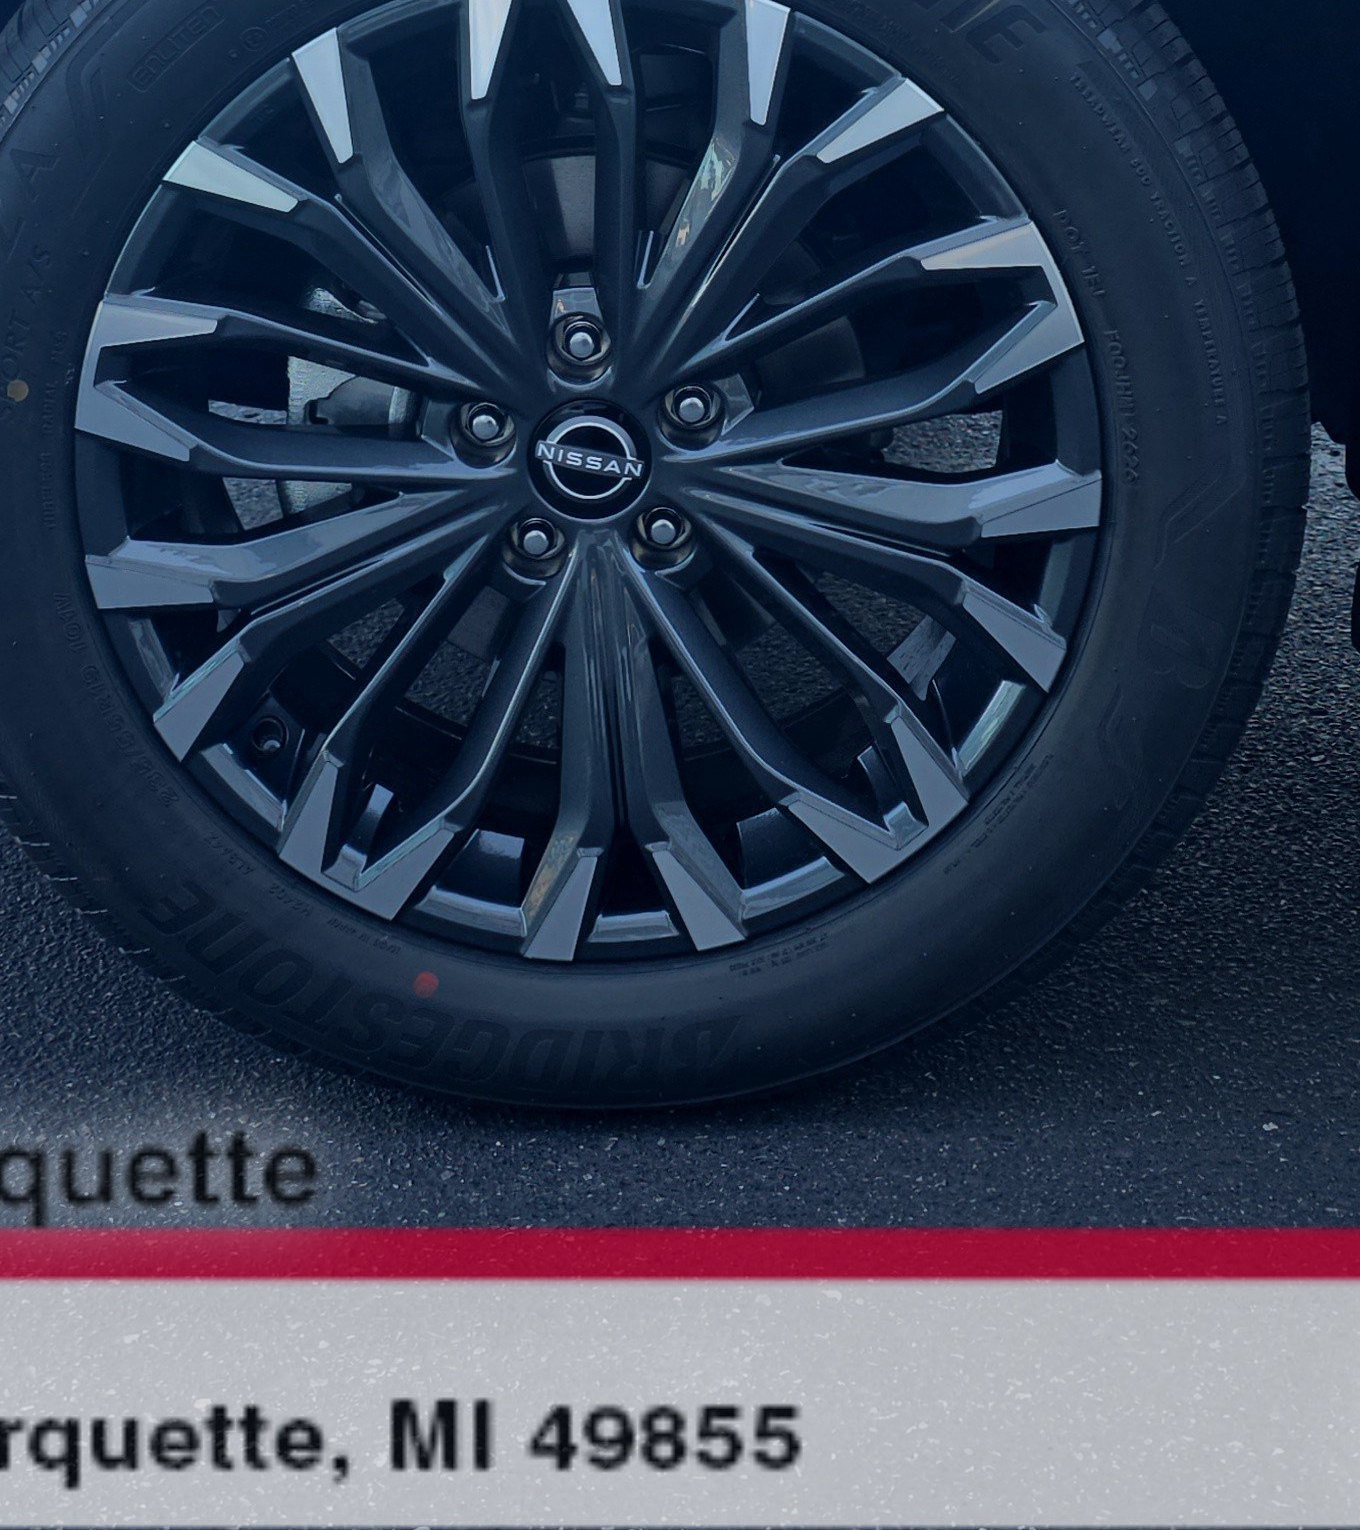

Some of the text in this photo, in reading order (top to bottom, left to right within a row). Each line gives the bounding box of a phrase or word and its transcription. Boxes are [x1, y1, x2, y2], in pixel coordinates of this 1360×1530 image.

[129, 1, 222, 90] ENLITEN
[1147, 191, 1191, 265] TRACTION
[1193, 298, 1226, 405] TEMPERATURE
[535, 441, 644, 480] NISSAN
[52, 591, 178, 809] 235/55R19 101V
[152, 879, 747, 1091] BRIDGESTONE
